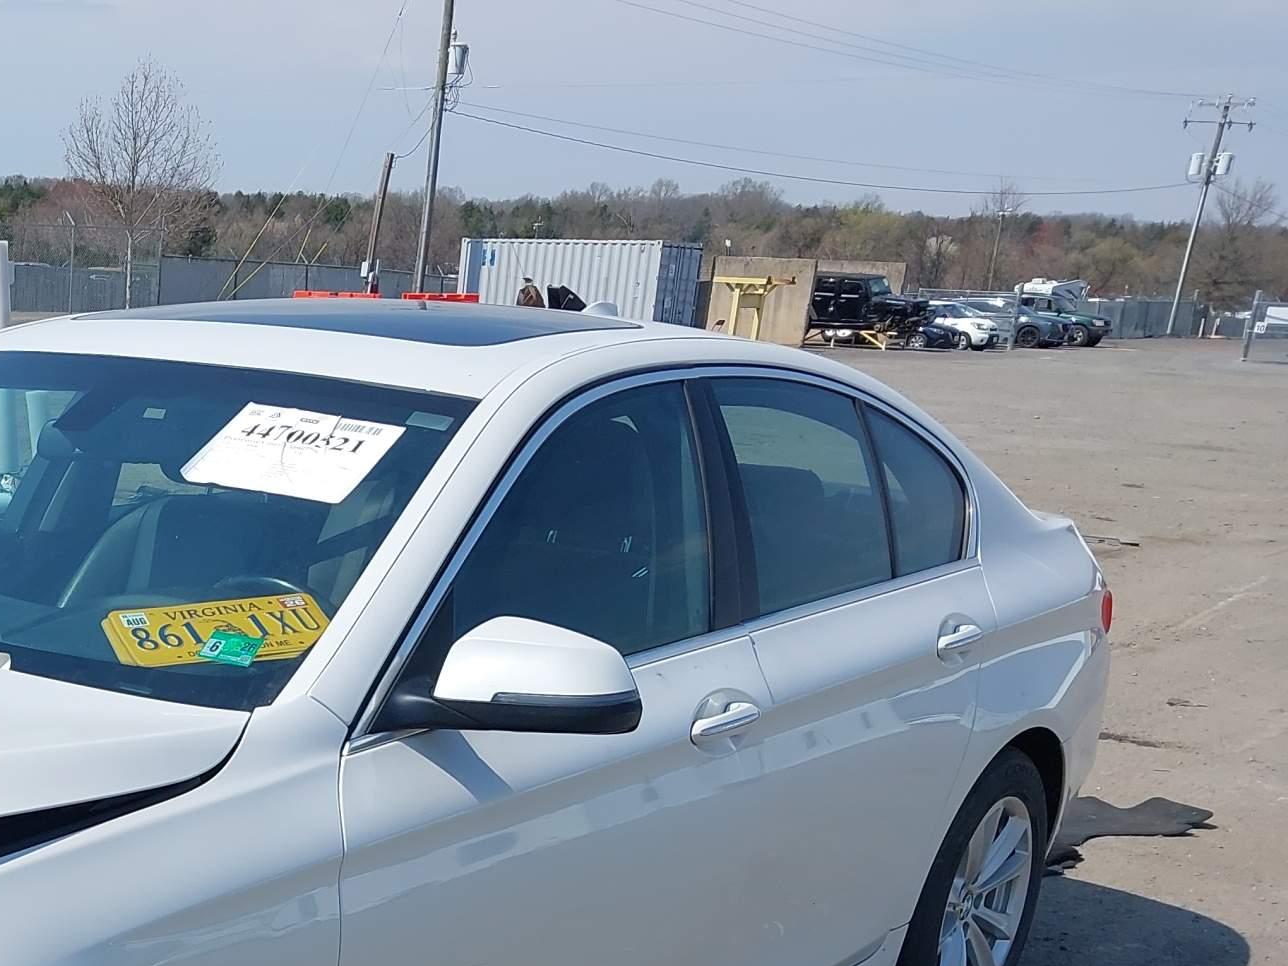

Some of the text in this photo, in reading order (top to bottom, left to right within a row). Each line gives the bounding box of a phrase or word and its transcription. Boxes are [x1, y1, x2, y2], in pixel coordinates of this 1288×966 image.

[241, 423, 365, 453] 44700521
[163, 602, 263, 621] VIRGINIA
[126, 617, 148, 626] AUG
[131, 606, 321, 651] 861 1XU
[209, 640, 257, 652] 6 26
